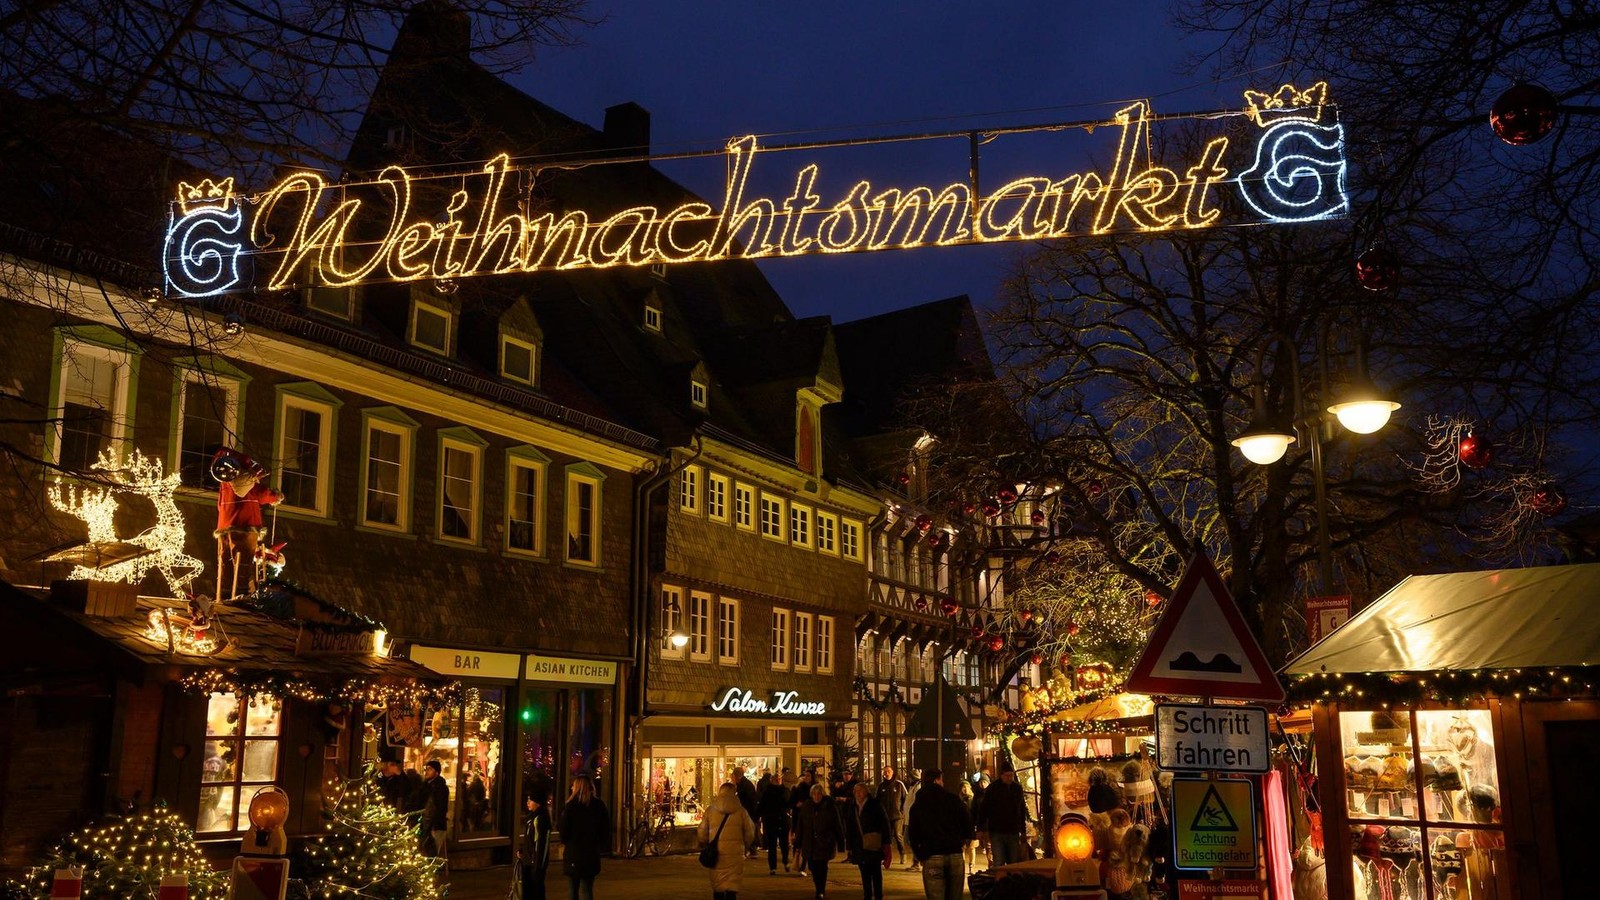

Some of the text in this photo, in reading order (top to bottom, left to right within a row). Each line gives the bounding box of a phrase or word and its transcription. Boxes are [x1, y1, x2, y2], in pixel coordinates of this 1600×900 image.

[251, 100, 1229, 291] Weihnachtsmarkt
[454, 655, 480, 670] BAR
[534, 662, 610, 677] ASIAN KITCHEN
[711, 687, 825, 715] Salon Kunze
[1174, 711, 1250, 735] Schritt
[1175, 741, 1251, 765] fahren
[1193, 833, 1237, 846] Achtung
[1181, 849, 1250, 862] Rutschgefahr
[1183, 883, 1260, 894] Weihnachtsmarkt
